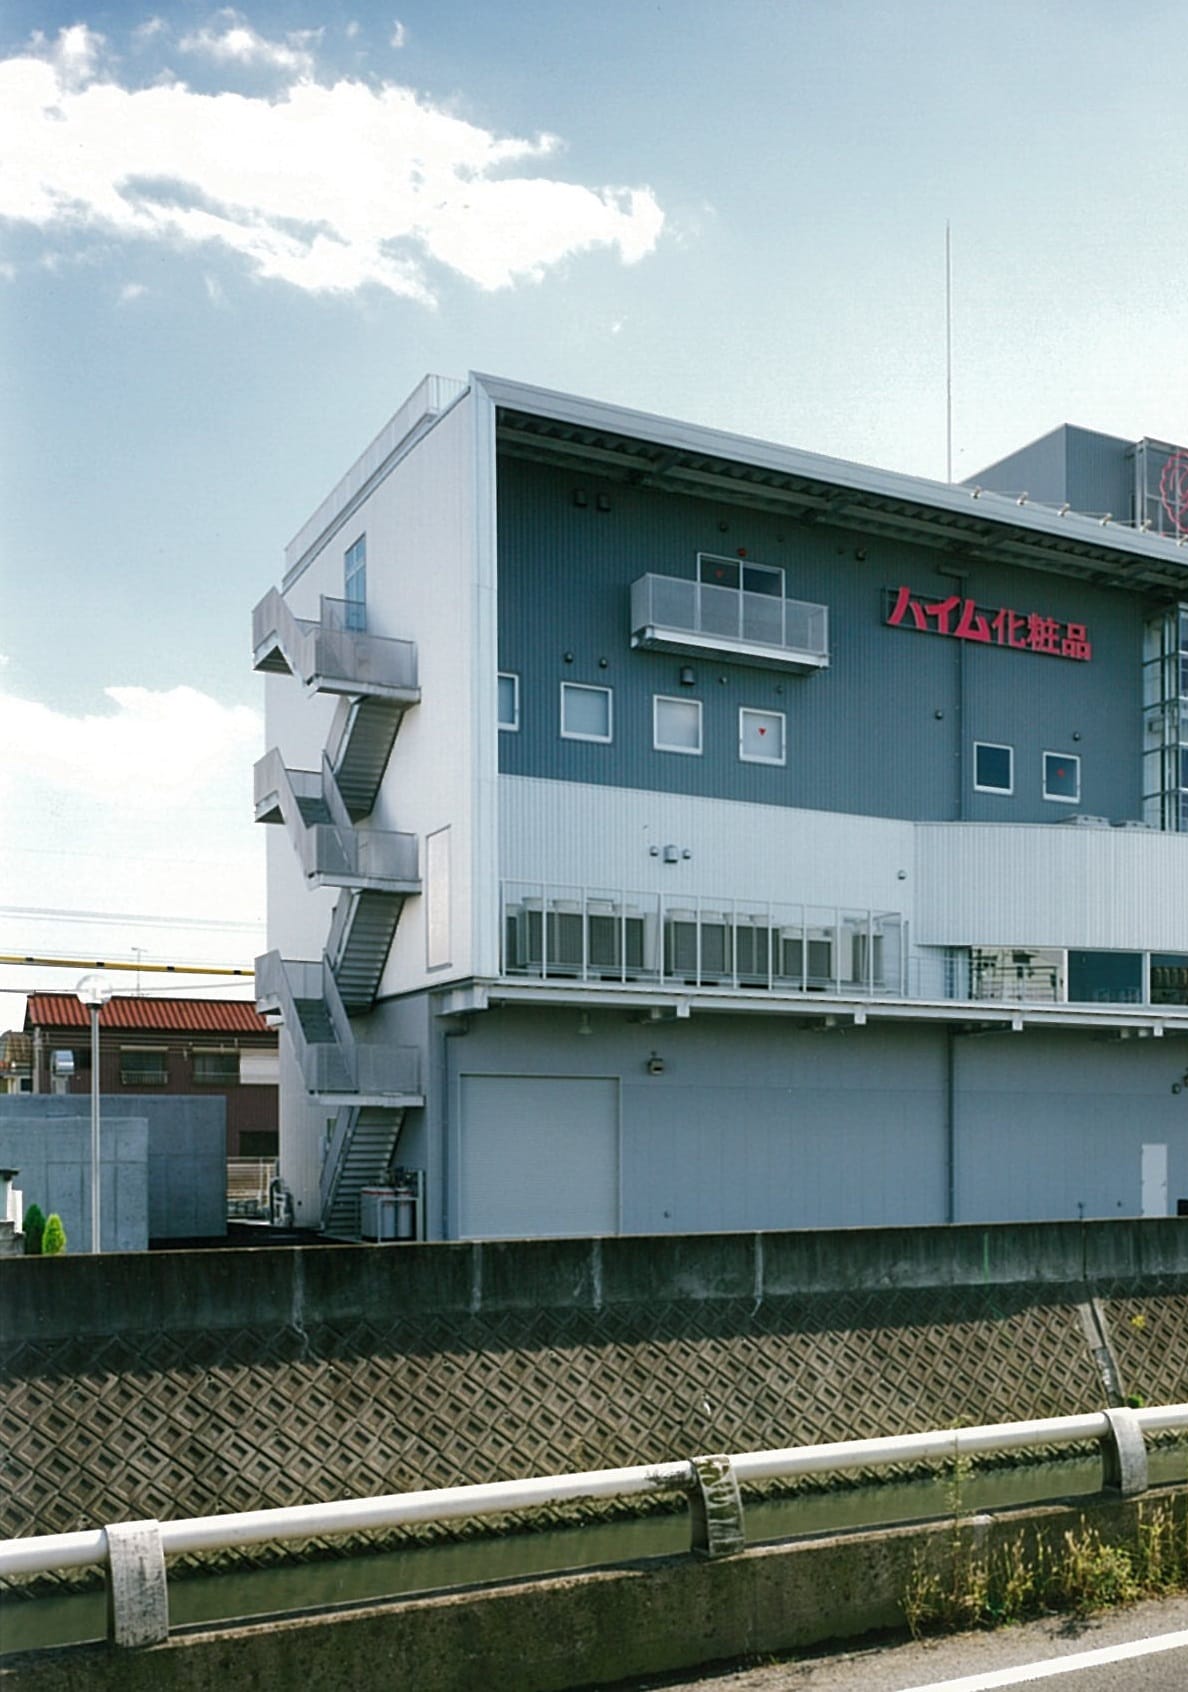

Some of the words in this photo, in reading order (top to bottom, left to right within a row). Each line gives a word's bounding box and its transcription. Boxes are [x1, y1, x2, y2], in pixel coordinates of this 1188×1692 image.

[888, 587, 1091, 660] ハイム化粧品
